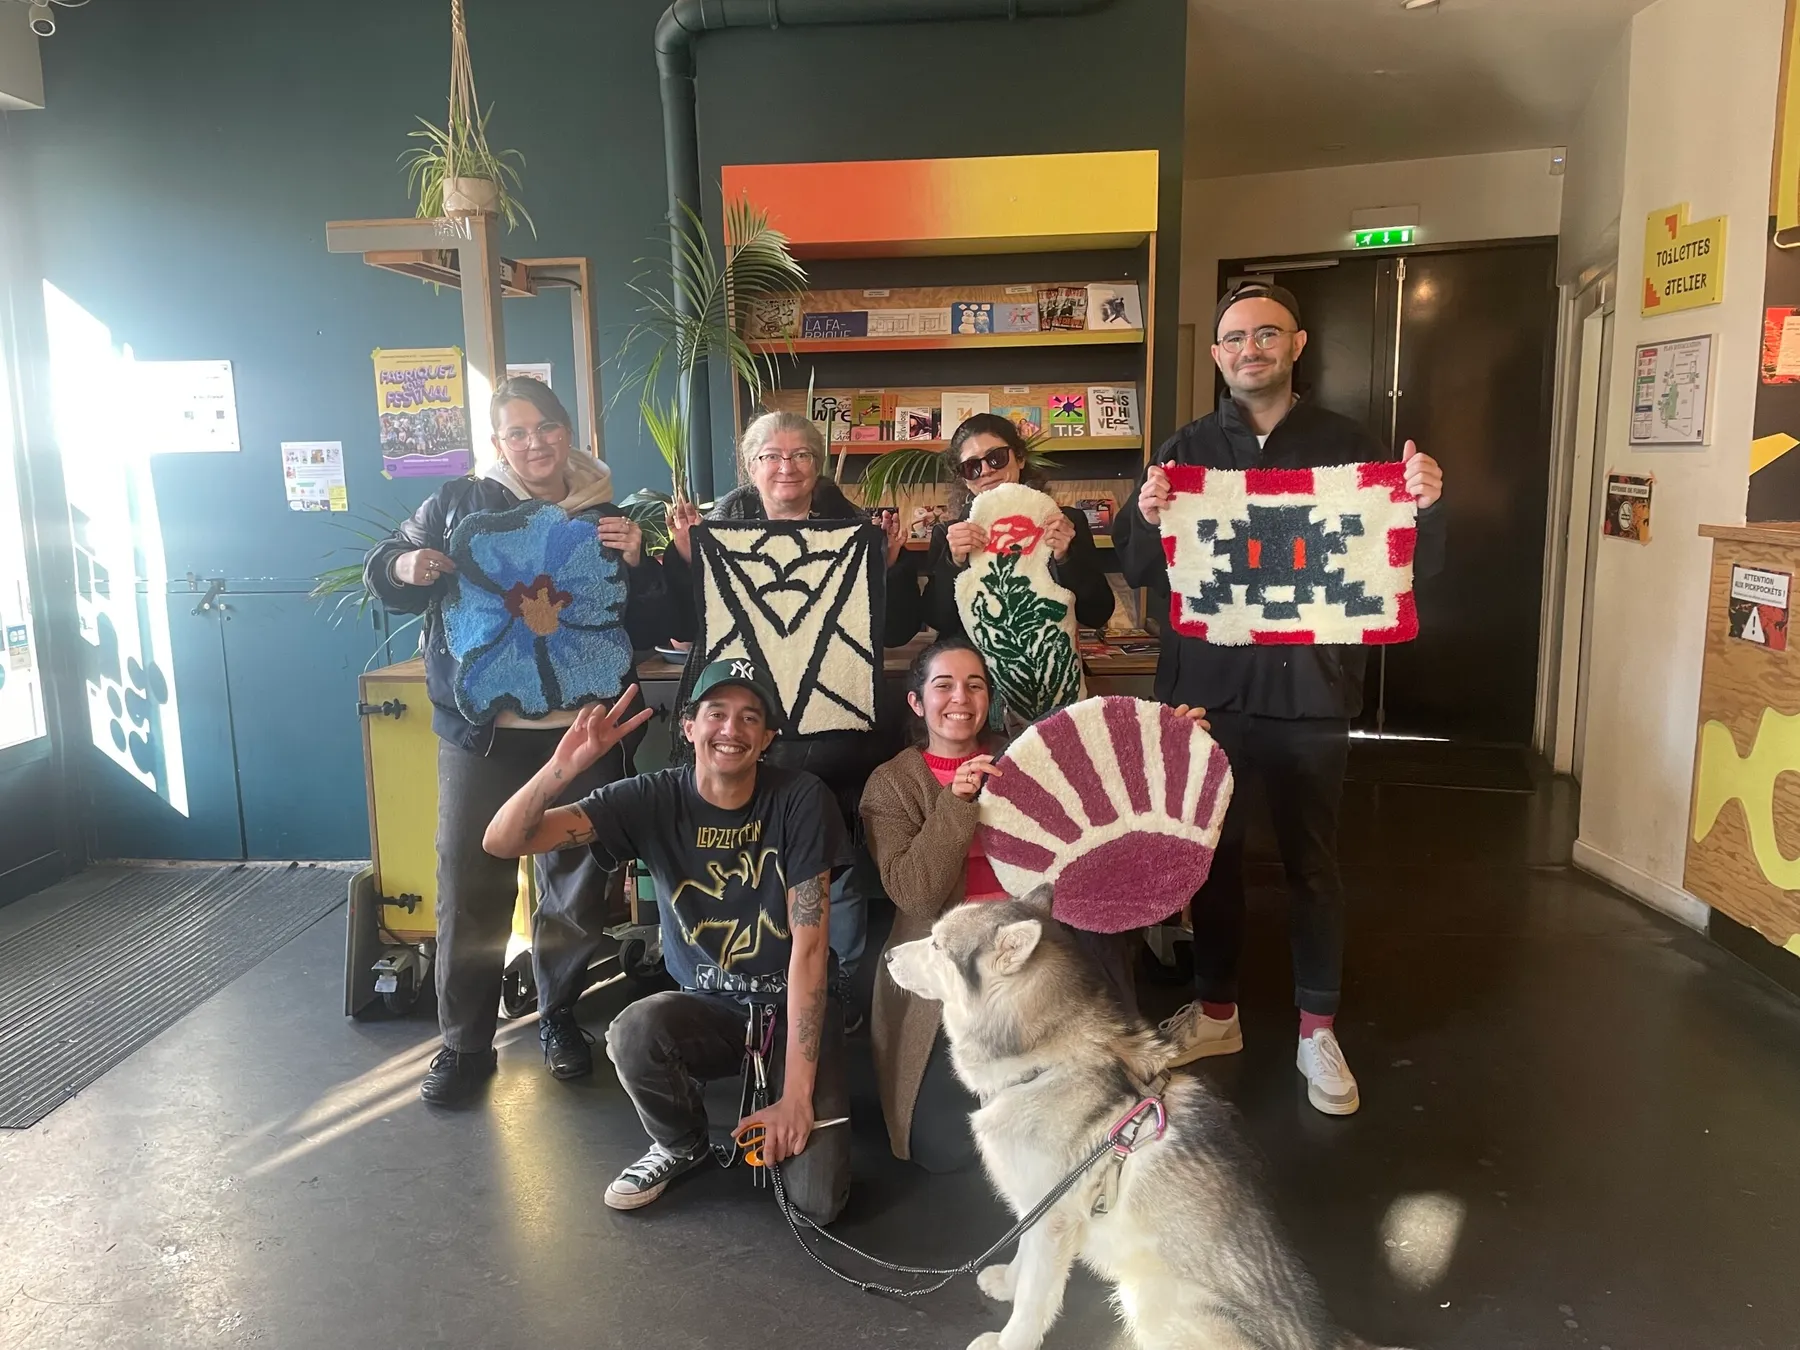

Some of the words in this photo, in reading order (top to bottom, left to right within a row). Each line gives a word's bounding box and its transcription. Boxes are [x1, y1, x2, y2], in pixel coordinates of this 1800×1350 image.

[805, 320, 821, 331] LA
[825, 319, 846, 331] FA-
[380, 363, 458, 385] FABRIQUEZ
[385, 385, 452, 408] FESTIVAL
[1053, 424, 1085, 437] T.13
[1734, 580, 1744, 588] AUX
[1744, 573, 1775, 585] ATTENTION
[730, 660, 755, 681] NY
